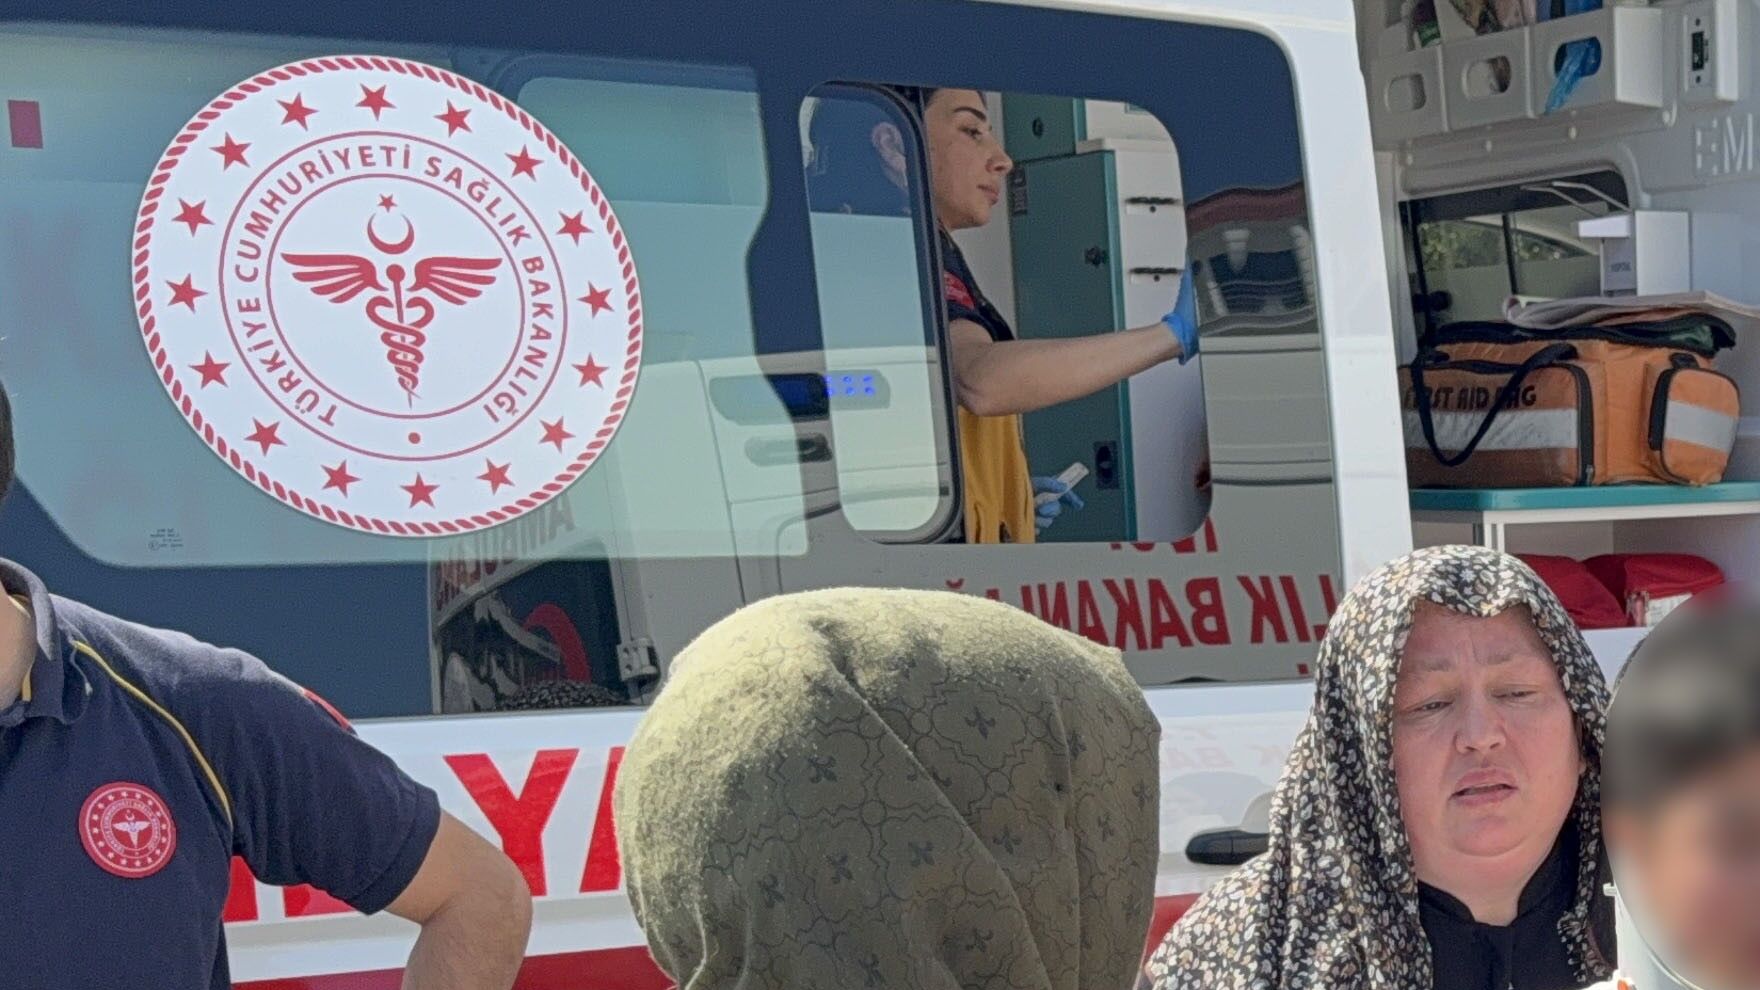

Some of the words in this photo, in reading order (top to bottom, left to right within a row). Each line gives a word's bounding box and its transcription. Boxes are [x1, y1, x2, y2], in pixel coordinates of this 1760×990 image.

[234, 143, 411, 283] CUMHURİYETİ
[423, 155, 532, 248] SAĞLIK
[236, 297, 338, 428] TÜRKİYE
[483, 255, 555, 423] BAKANLIĞI
